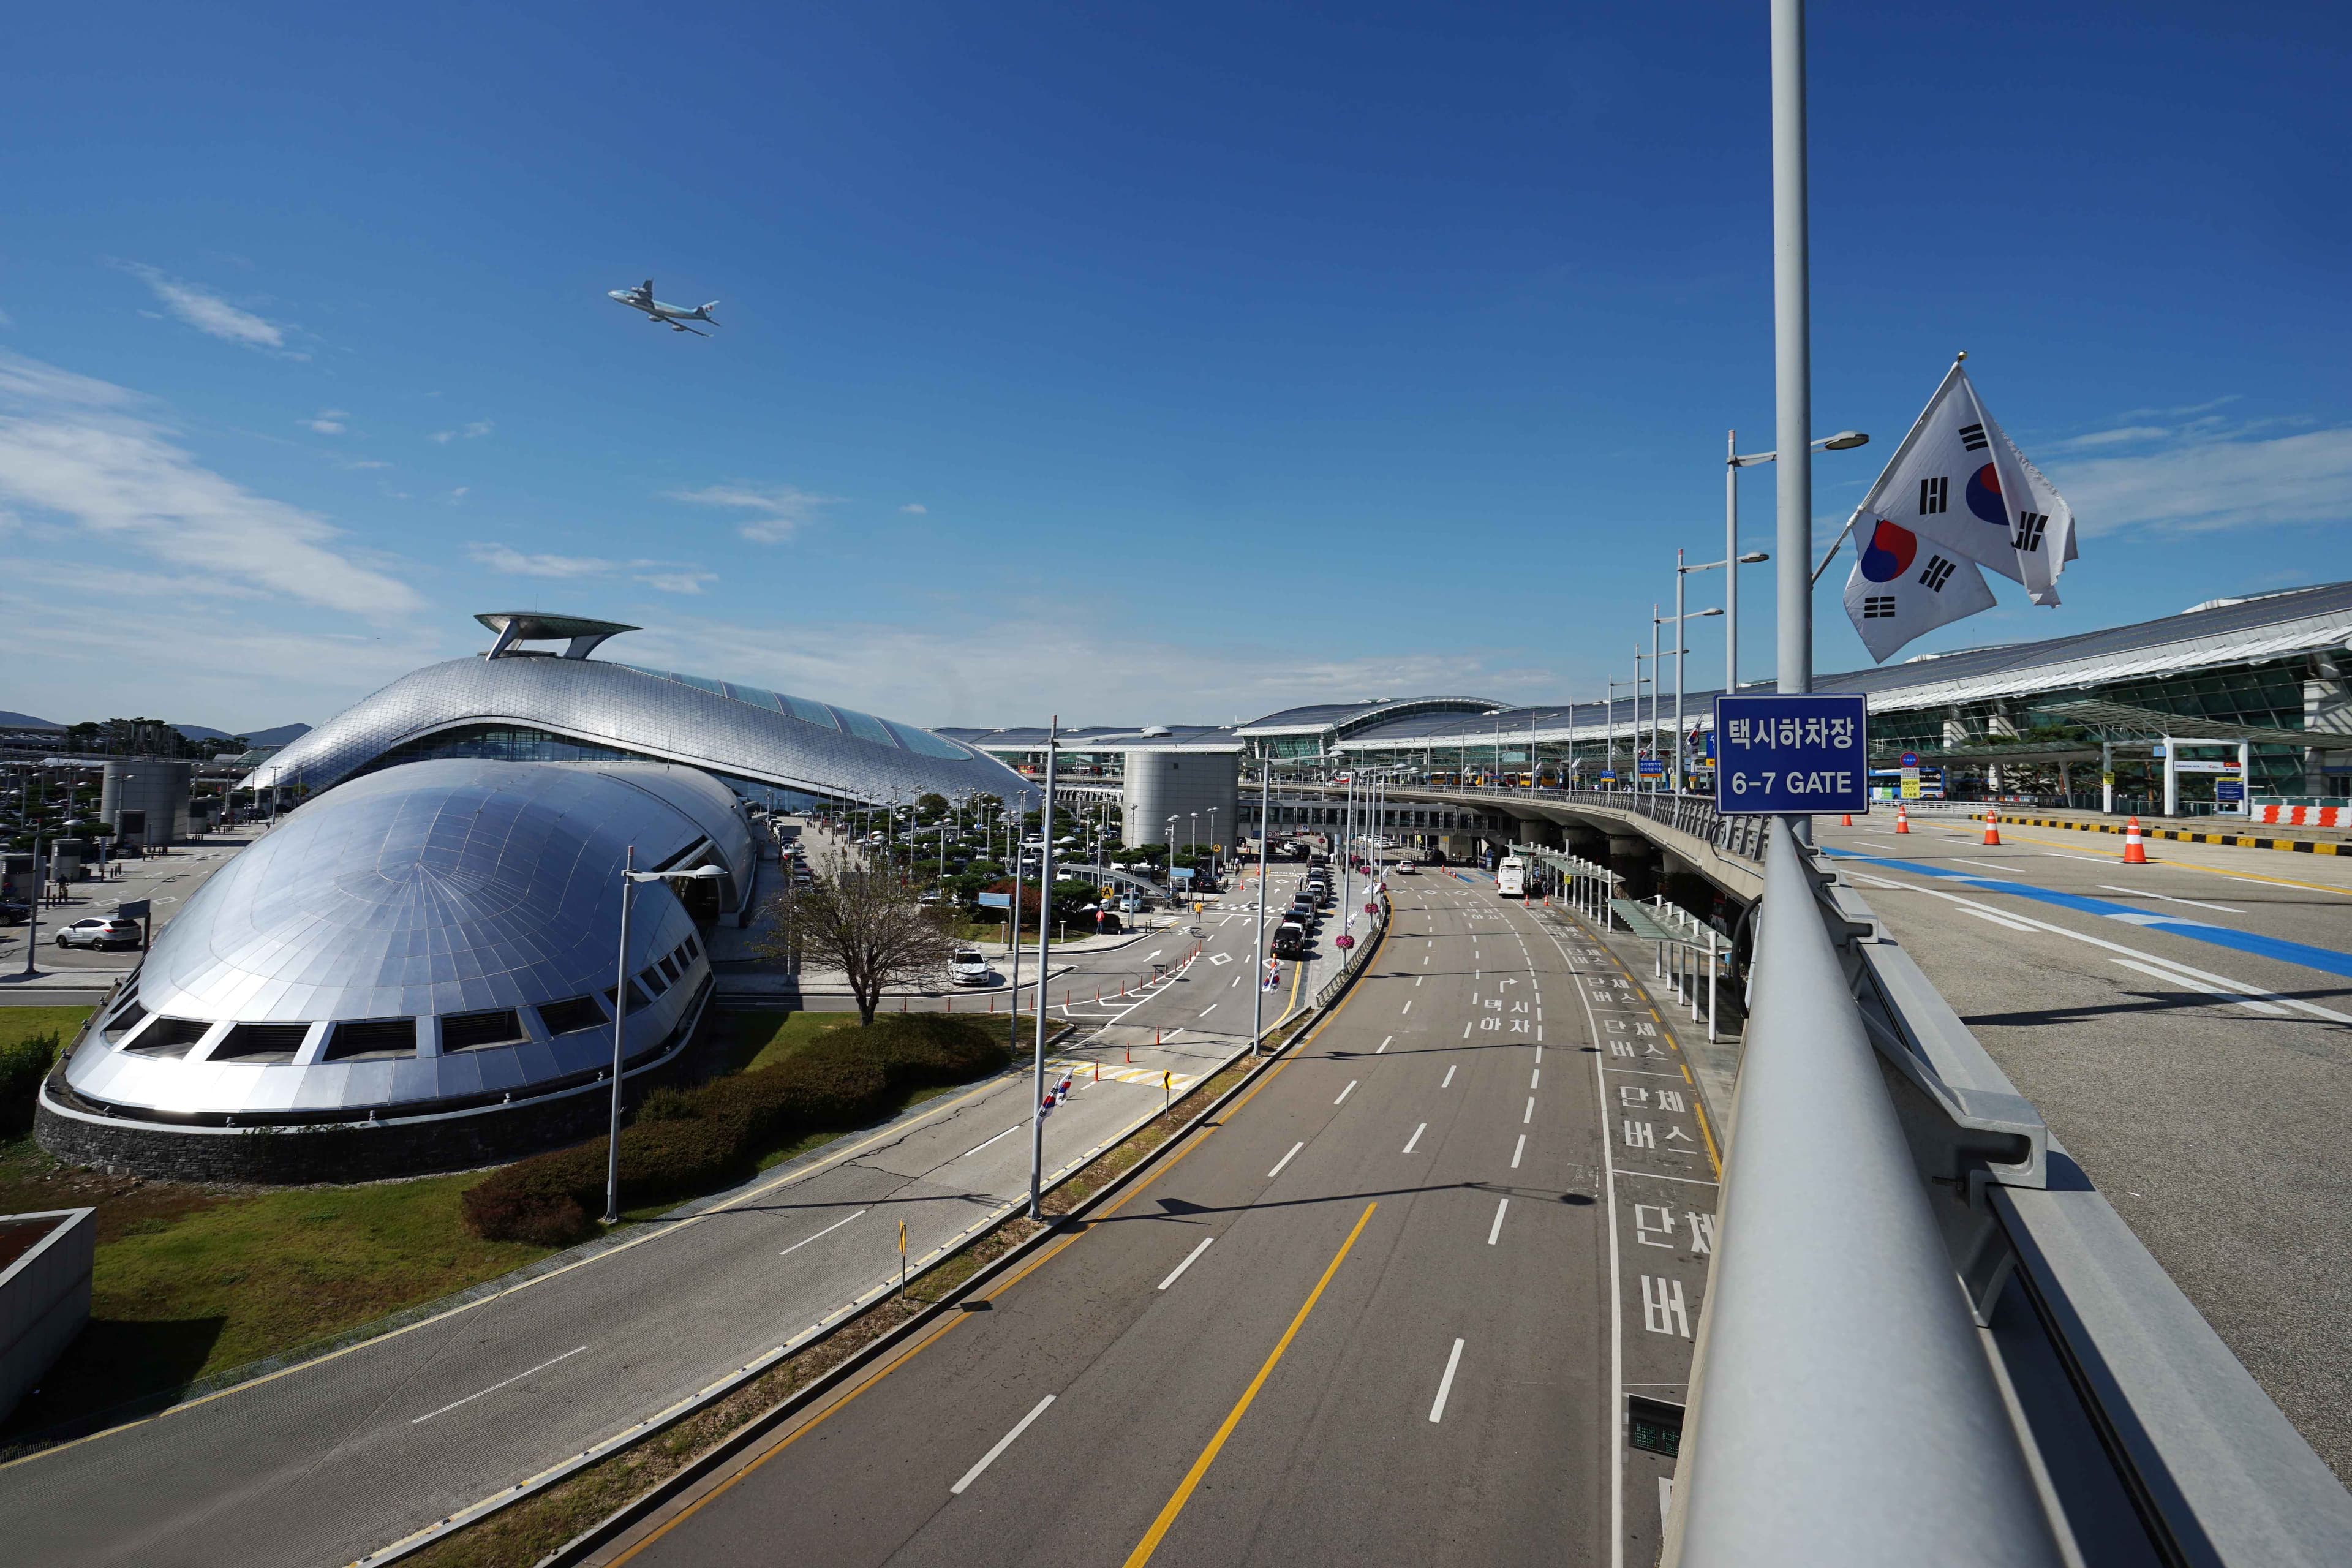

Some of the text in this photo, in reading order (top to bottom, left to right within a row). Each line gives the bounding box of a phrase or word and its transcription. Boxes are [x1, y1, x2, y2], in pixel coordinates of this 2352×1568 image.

[1728, 717, 1854, 750] 택시하차장
[1732, 771, 1852, 794] 6-7 GATE
[1103, 888, 1111, 897] A
[1572, 956, 1609, 965] 버스
[1586, 977, 1630, 989] 단체
[1484, 999, 1528, 1013] 택시
[1593, 991, 1640, 1005] 버스
[1480, 1017, 1530, 1033] 하차
[1604, 1019, 1657, 1036] 단체
[1610, 1041, 1669, 1060] 버스
[1619, 1086, 1686, 1112] 단체
[1624, 1120, 1698, 1155] 버스
